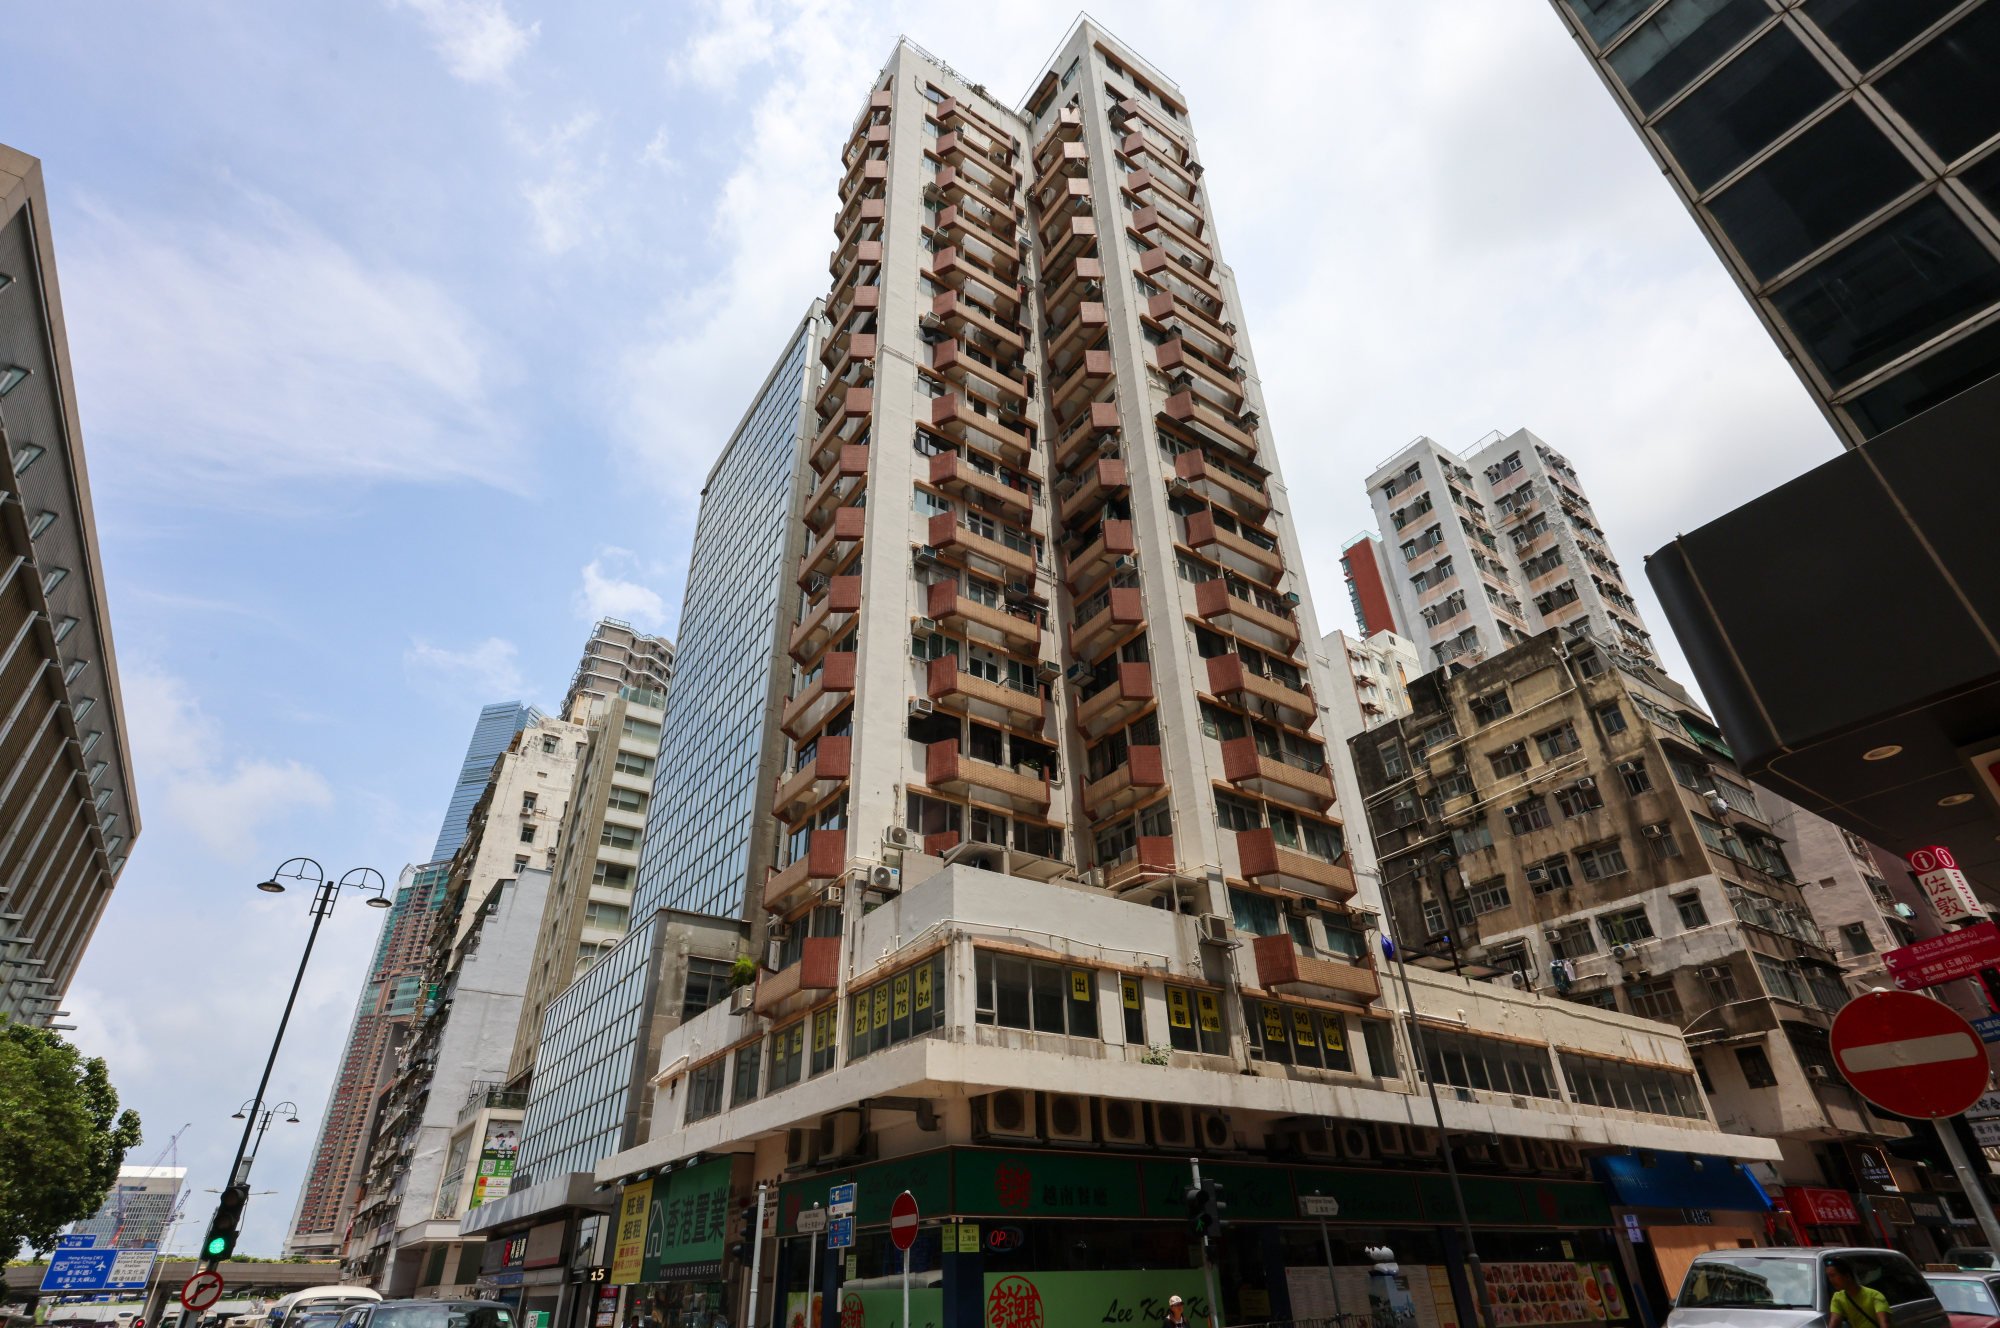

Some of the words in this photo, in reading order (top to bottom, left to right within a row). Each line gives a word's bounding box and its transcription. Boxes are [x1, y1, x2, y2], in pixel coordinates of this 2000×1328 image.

[1924, 875, 1965, 917] 佐敦
[1952, 871, 1983, 914] Jordan
[1926, 971, 1947, 981] Canton
[1948, 966, 1965, 976] Road
[1965, 960, 1983, 971] (Jade
[876, 988, 887, 1005] 59
[896, 979, 908, 995] 00
[919, 969, 928, 985] 呎
[1074, 978, 1086, 993] 出
[1124, 987, 1136, 1002] 租
[857, 1016, 867, 1032] 27
[875, 1007, 887, 1025] 37
[896, 999, 907, 1016] 76
[918, 990, 930, 1007] 64
[1172, 991, 1183, 1005] 面
[1202, 996, 1213, 1010] 積
[1175, 1010, 1186, 1024] 劉
[1202, 1015, 1219, 1028] 小姐
[1295, 1012, 1308, 1025] 90
[1266, 1025, 1284, 1037] 273
[1297, 1030, 1313, 1042] 776
[1328, 1035, 1340, 1046] 64
[666, 1186, 727, 1248] 香港置業
[623, 1220, 641, 1240] 招租
[990, 1230, 1019, 1248] OPEN
[590, 1269, 605, 1281] 15
[661, 1267, 674, 1278] HONG
[675, 1267, 689, 1277] KONG
[691, 1264, 722, 1276] PROPERTY
[1102, 1299, 1134, 1323] Lee
[1140, 1298, 1171, 1321] Ka
[1187, 1296, 1211, 1319] Ke
